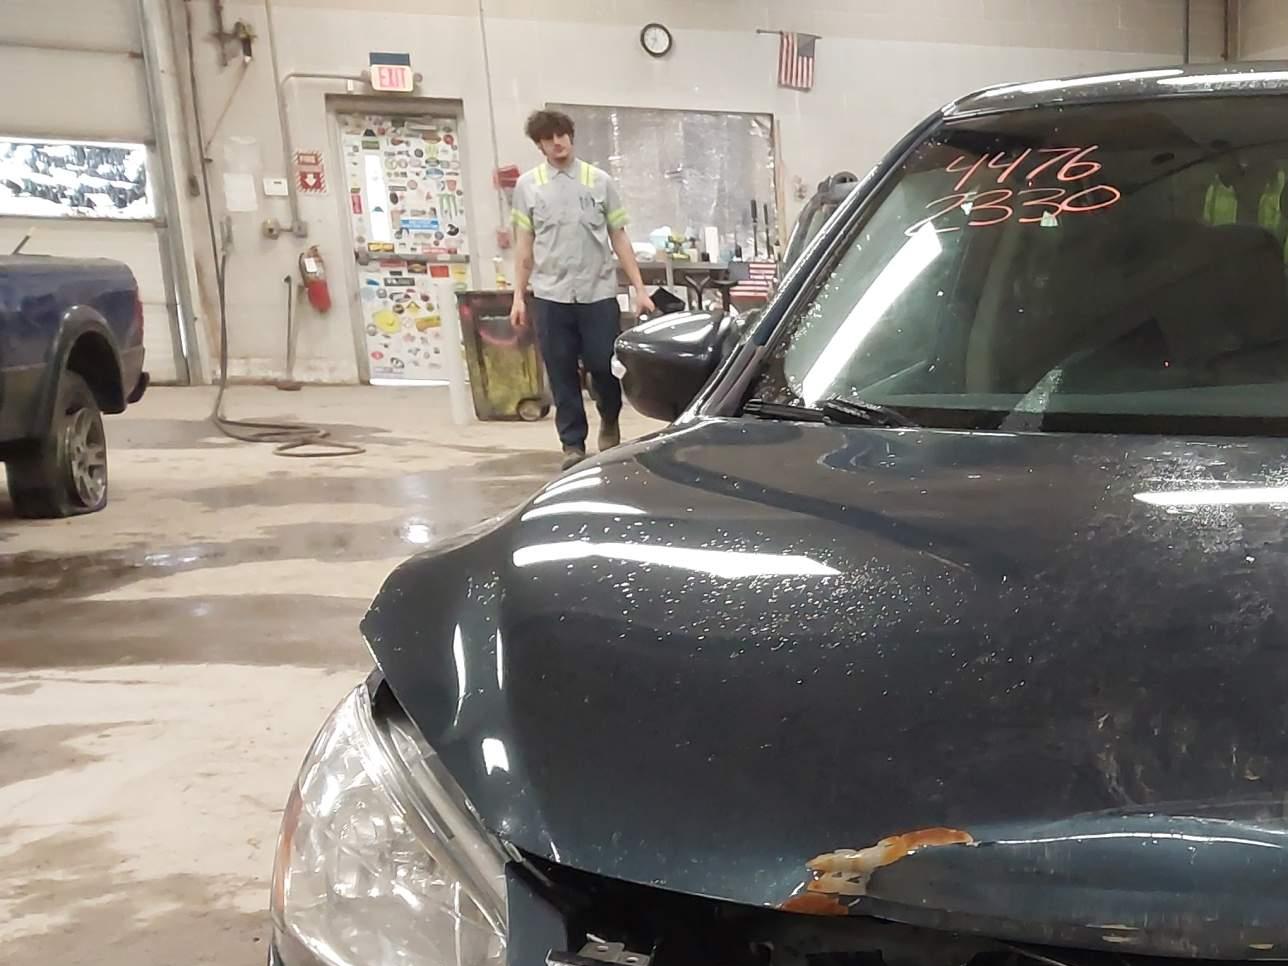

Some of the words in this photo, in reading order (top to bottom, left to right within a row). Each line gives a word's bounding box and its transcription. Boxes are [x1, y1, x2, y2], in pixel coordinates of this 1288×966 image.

[378, 66, 406, 89] EXIT
[945, 145, 1102, 191] 4476
[904, 185, 1121, 237] 2330
